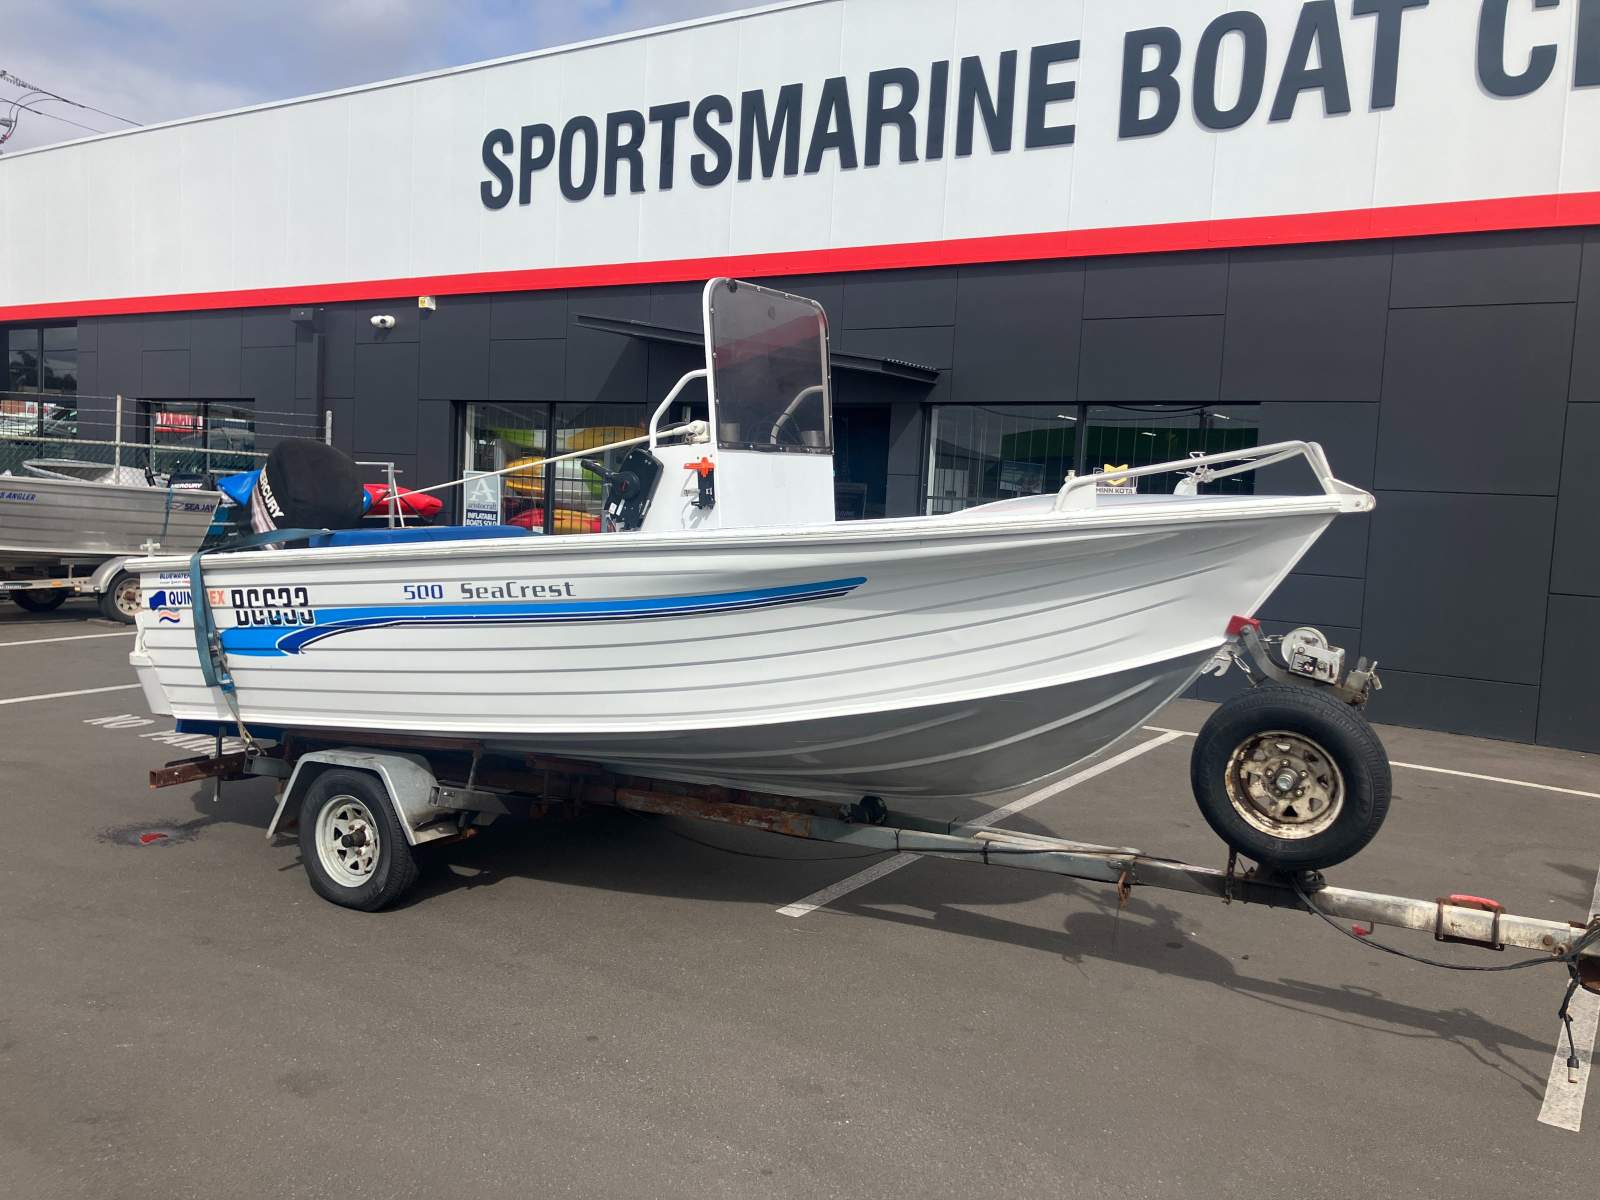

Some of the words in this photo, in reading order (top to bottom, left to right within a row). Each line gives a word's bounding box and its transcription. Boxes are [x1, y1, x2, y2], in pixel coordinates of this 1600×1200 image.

[480, 39, 1081, 210] SPORTSMARINE
[1118, 0, 1429, 139] BOAT
[1476, 0, 1600, 98] C
[467, 512, 497, 520] INFLATABLE
[169, 590, 226, 606] QUINEX
[403, 584, 443, 600] 500
[460, 581, 577, 599] SeaCrest
